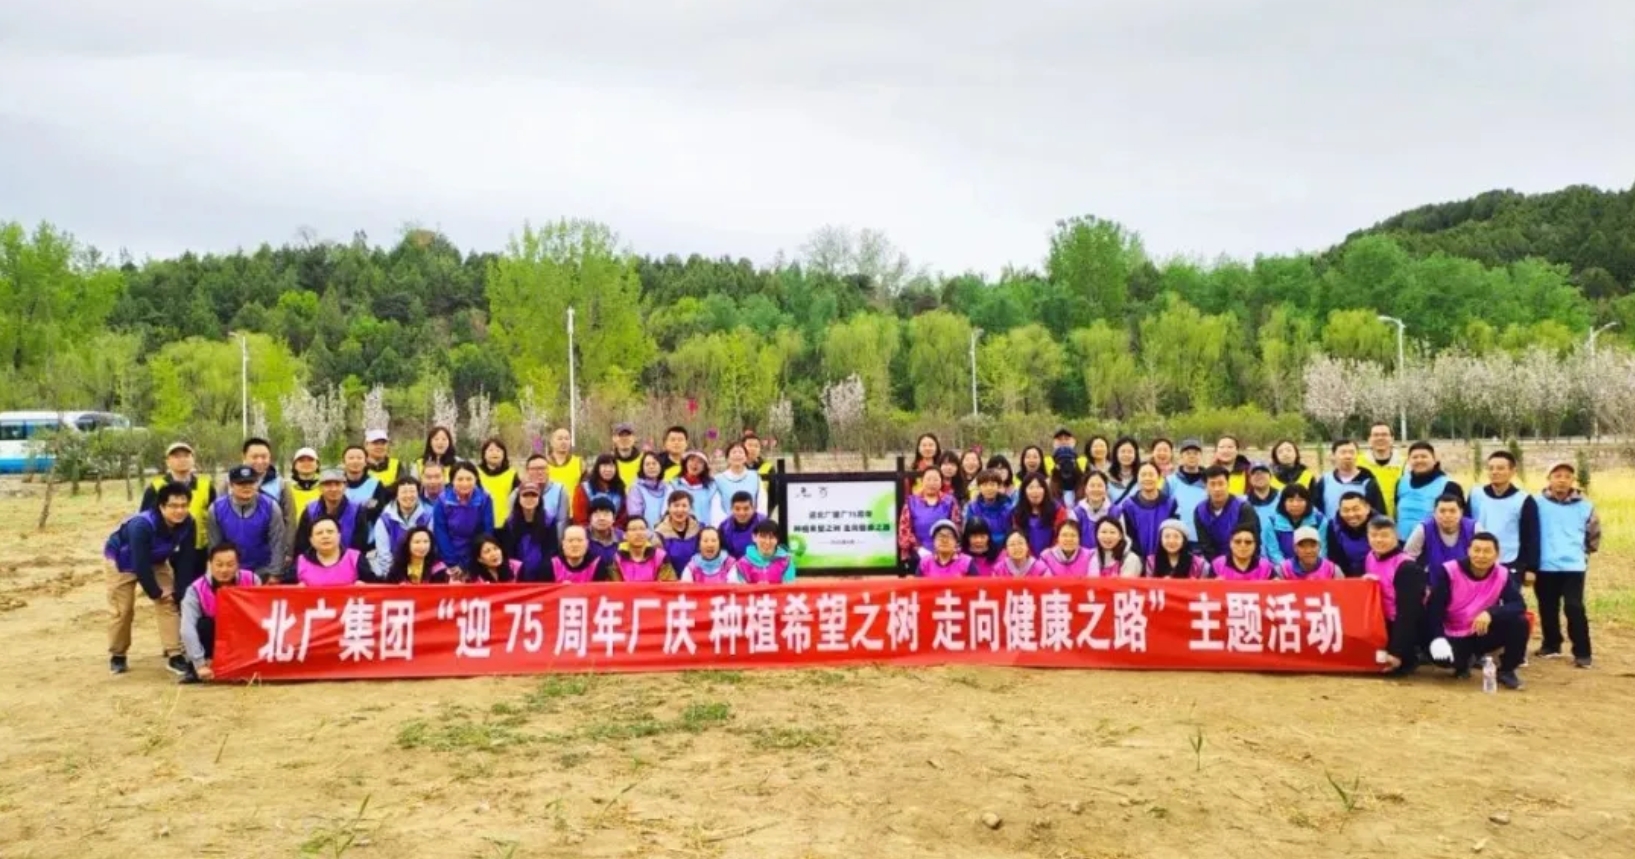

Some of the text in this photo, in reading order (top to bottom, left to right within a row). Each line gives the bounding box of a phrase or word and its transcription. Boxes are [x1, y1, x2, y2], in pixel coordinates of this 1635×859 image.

[709, 593, 919, 655] 种植希望之树
[1189, 591, 1342, 654] 主题活动
